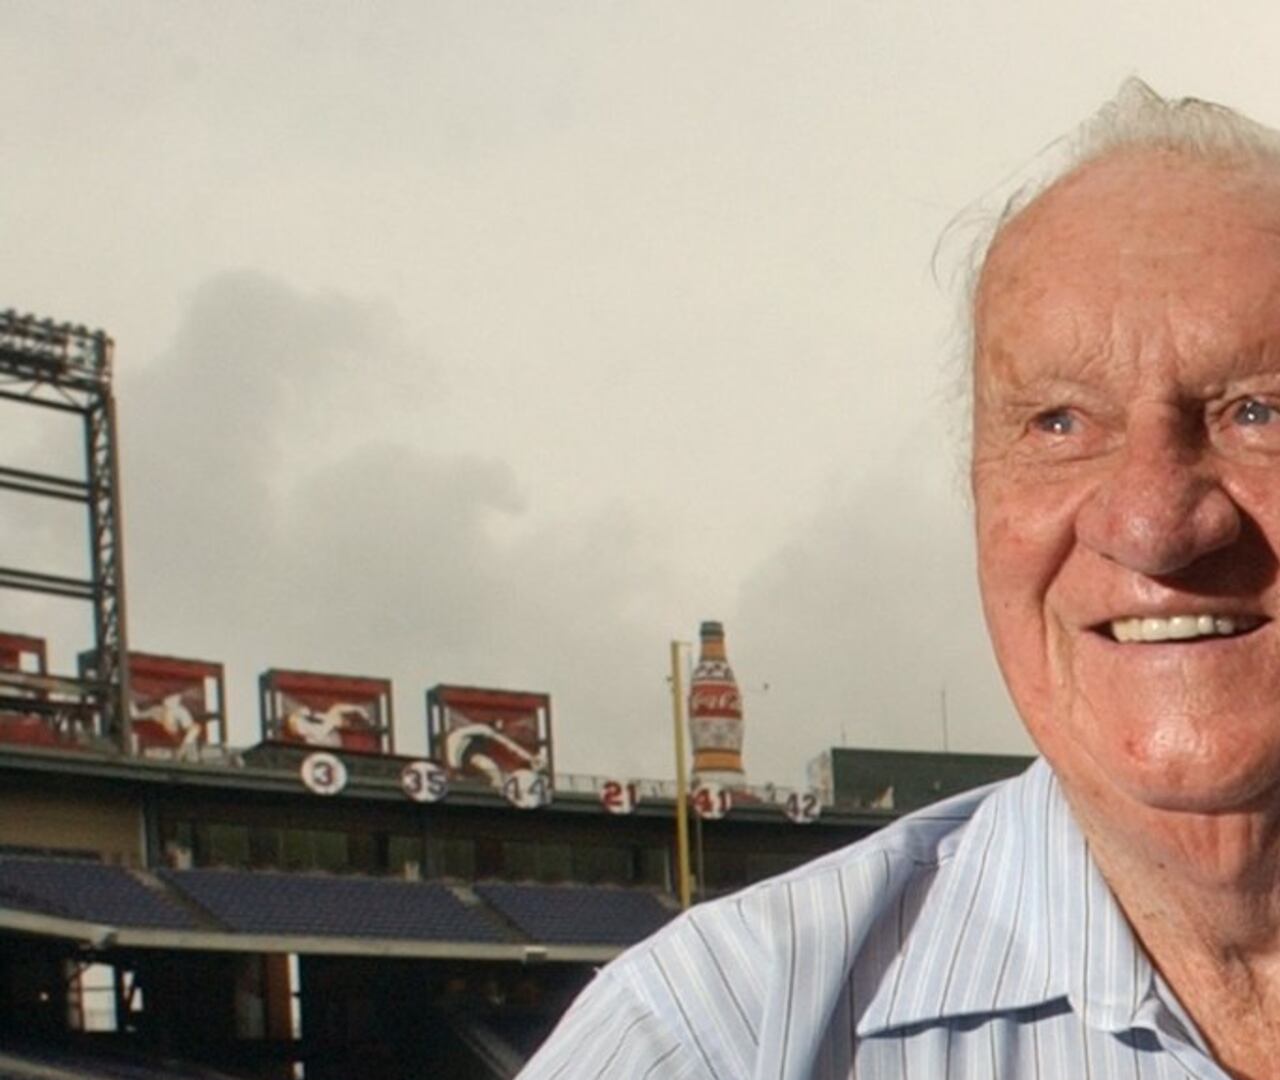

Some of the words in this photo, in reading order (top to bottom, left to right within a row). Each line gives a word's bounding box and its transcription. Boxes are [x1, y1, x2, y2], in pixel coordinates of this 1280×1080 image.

[312, 762, 334, 786] 3
[403, 768, 448, 797] 35
[502, 775, 547, 801] 44
[603, 780, 637, 807] 21
[694, 788, 731, 814] 41
[786, 793, 817, 818] 42
